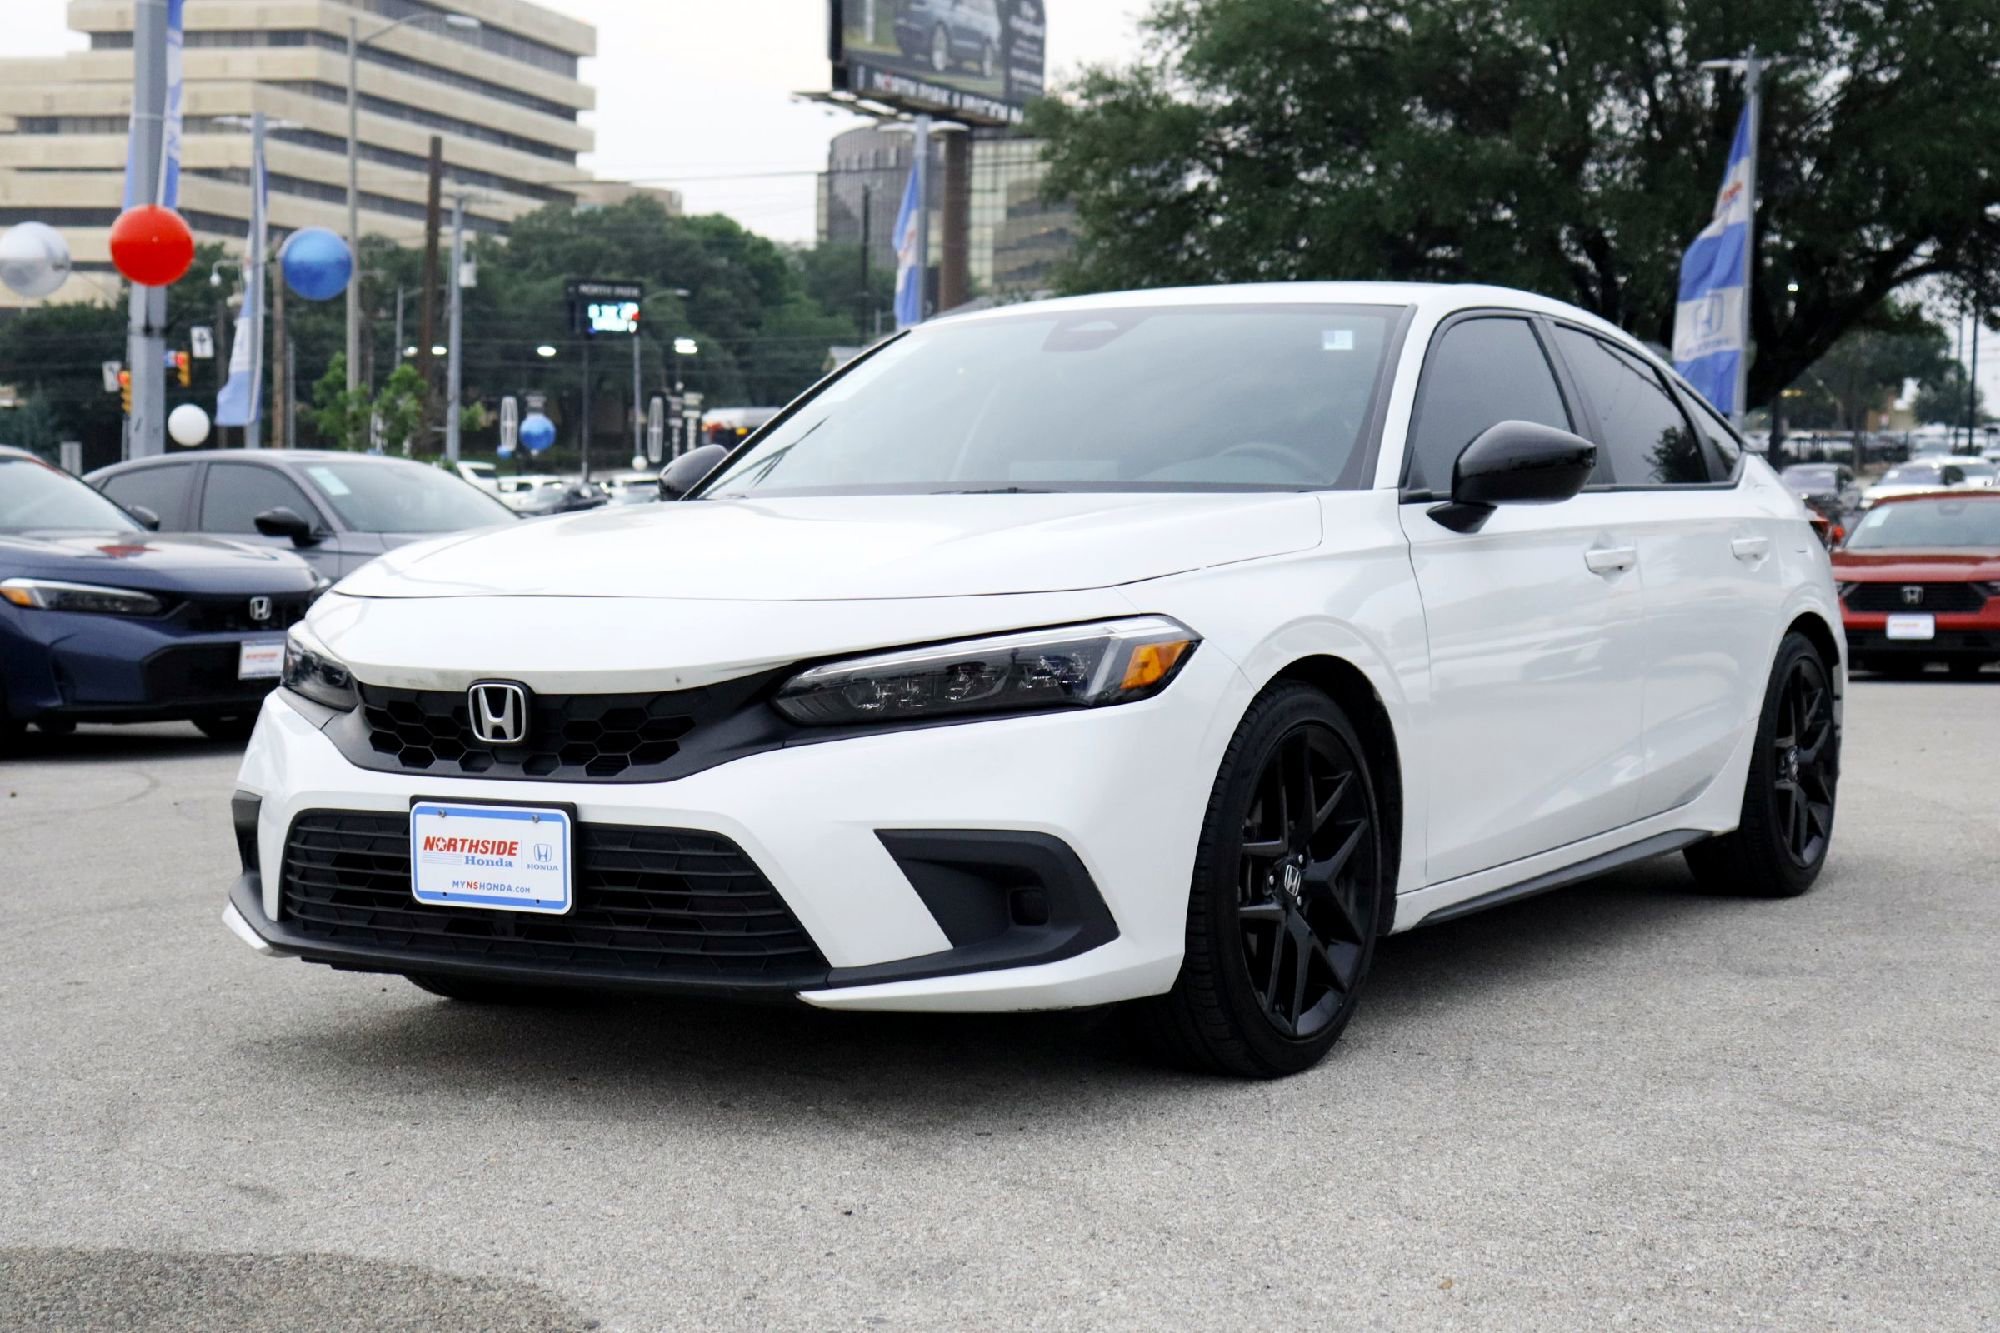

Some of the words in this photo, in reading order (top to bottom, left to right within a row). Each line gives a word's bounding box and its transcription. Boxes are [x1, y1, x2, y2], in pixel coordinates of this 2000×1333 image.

[423, 836, 518, 856] NORTHSIDE
[464, 855, 513, 868] Honda
[526, 863, 559, 871] HONDA
[452, 880, 531, 894] MYNSHONDA.COM
